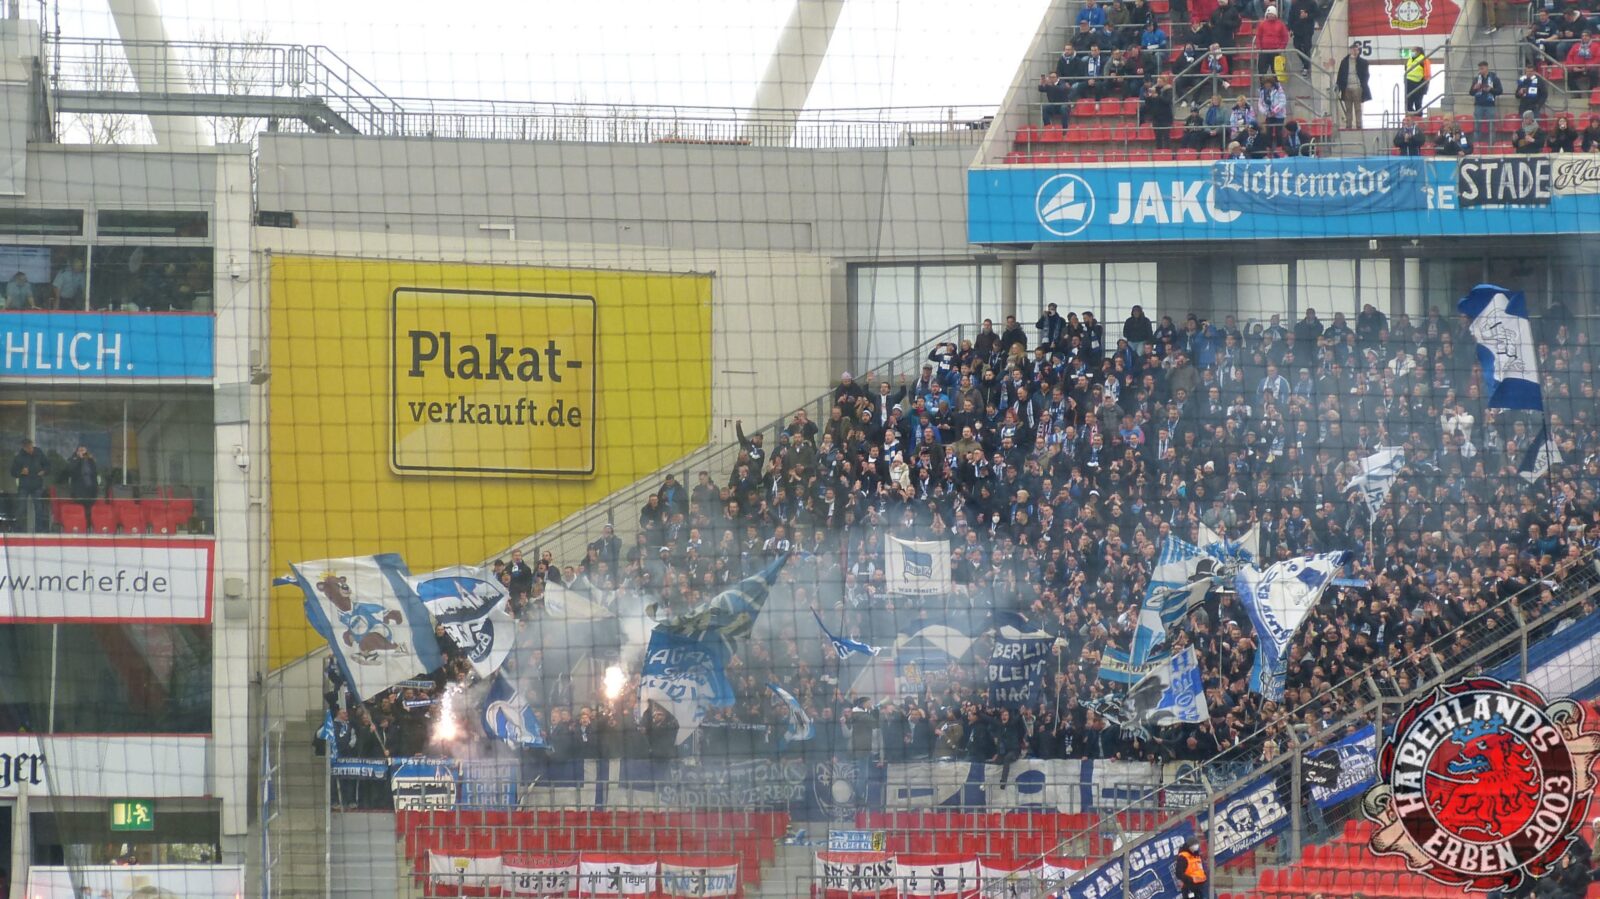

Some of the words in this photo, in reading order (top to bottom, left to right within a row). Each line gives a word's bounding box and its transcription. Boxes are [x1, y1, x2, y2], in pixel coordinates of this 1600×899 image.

[1218, 161, 1390, 199] Lichtenrade
[1460, 160, 1551, 200] STADE
[0, 332, 134, 370] HLICH.
[408, 330, 583, 383] Plakat-
[408, 396, 582, 427] verkauft.de
[1083, 862, 1124, 899] FAN
